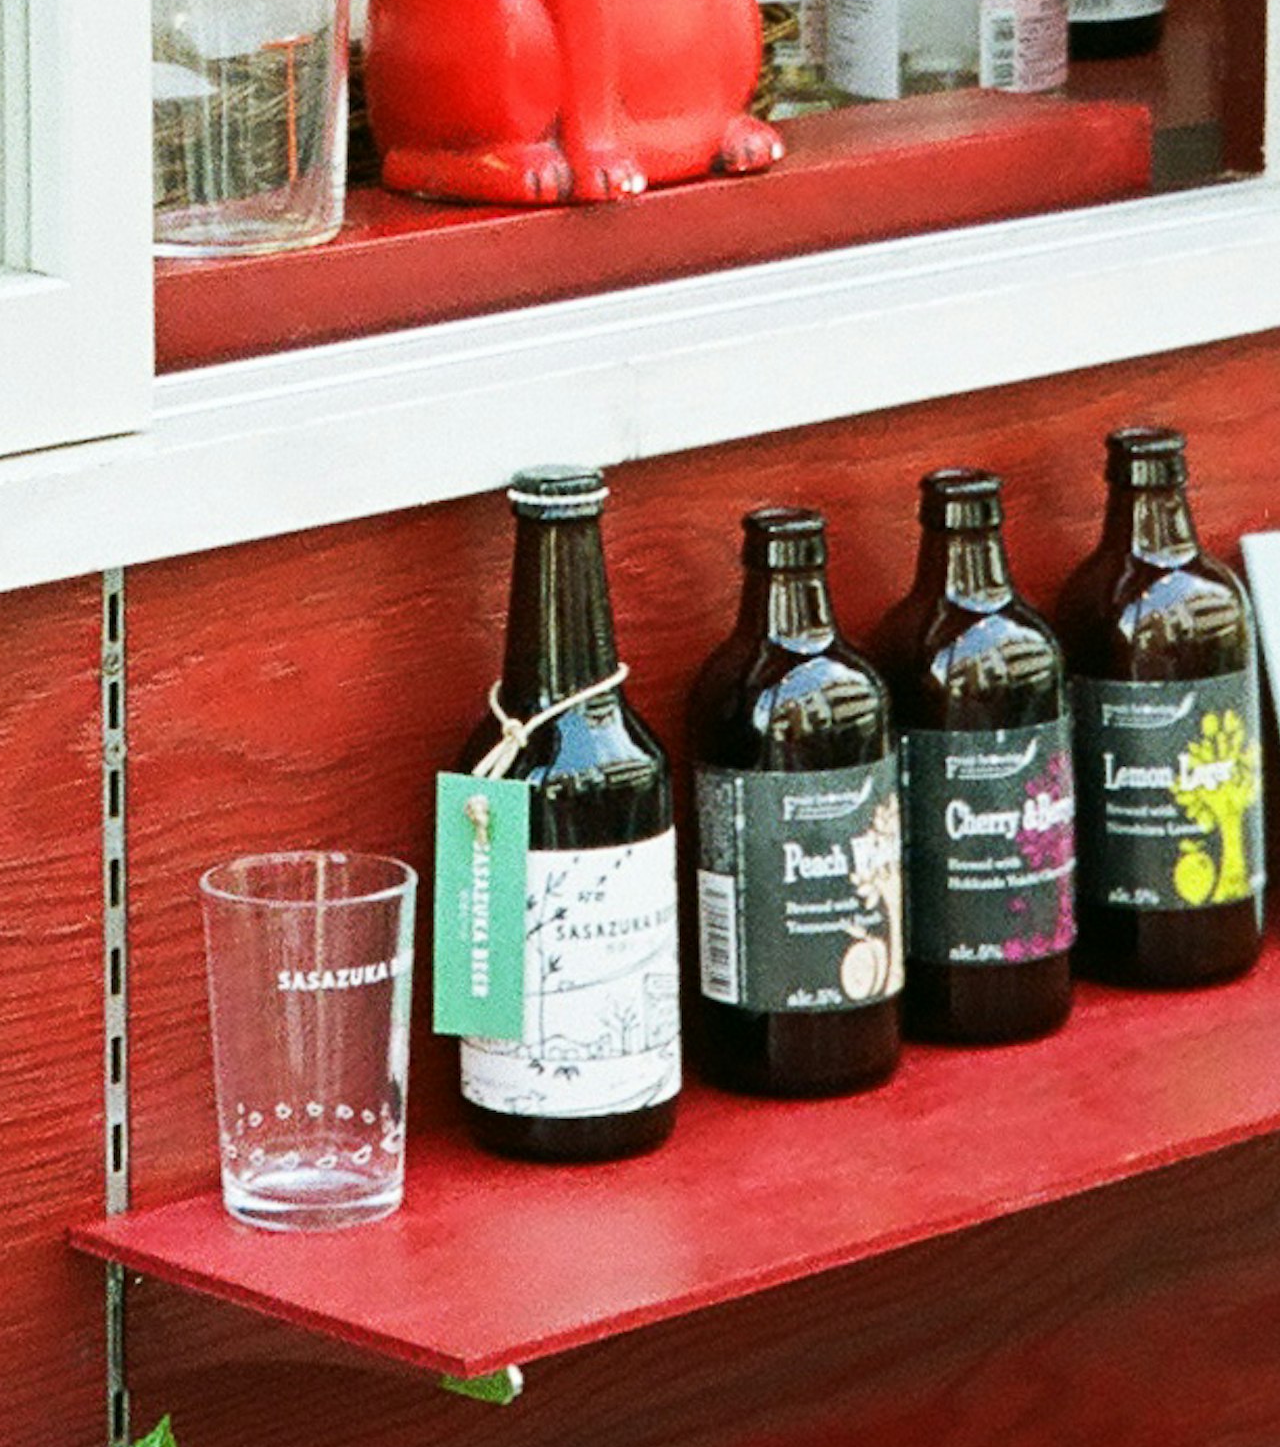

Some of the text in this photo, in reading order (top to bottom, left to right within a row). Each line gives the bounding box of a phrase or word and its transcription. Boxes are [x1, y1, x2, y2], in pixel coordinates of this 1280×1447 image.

[1103, 752, 1173, 791] Lemon
[945, 799, 1021, 841] Cherry
[782, 842, 849, 884] Peach
[472, 948, 491, 998] BEER
